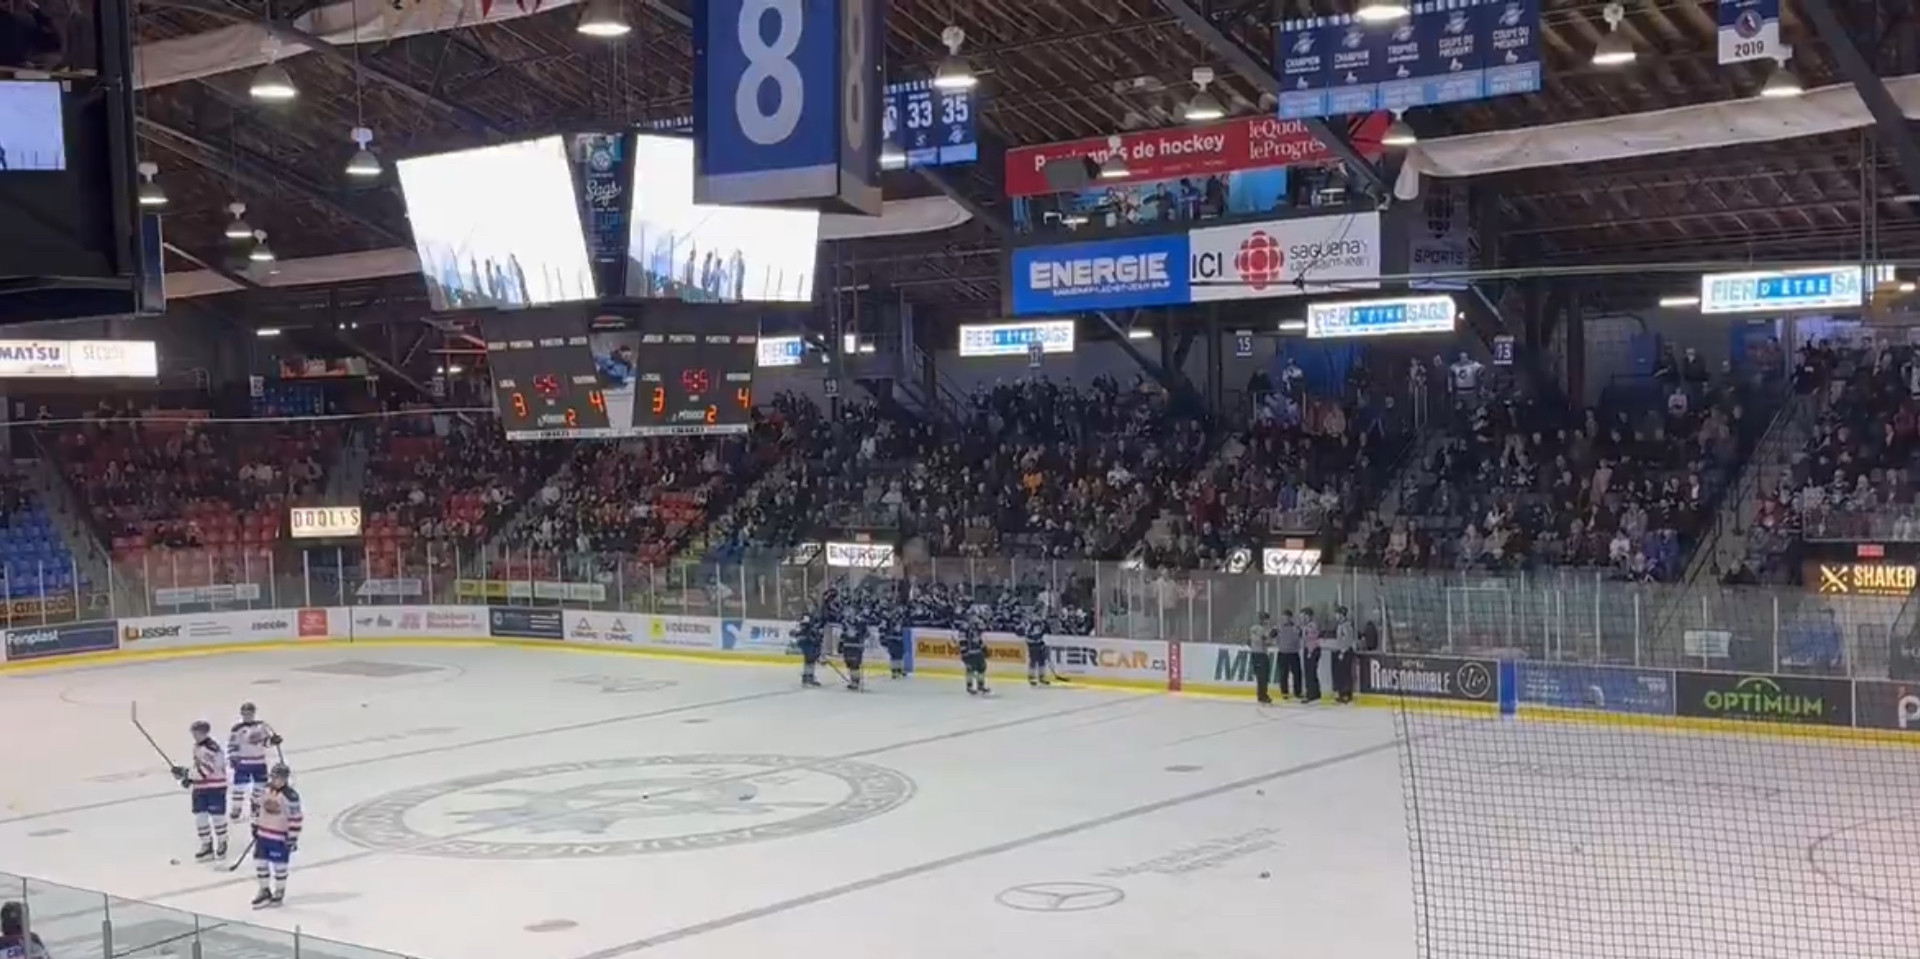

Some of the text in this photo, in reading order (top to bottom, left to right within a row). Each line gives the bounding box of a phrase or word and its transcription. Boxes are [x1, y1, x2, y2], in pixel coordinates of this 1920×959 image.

[736, 0, 804, 145] 8
[907, 100, 933, 128] 33
[941, 96, 969, 124] 35
[1133, 141, 1155, 159] de
[1160, 134, 1225, 156] hockey
[1191, 252, 1223, 279] ICI
[1238, 337, 1251, 352] 15
[588, 389, 604, 413] 4
[652, 387, 665, 413] 3
[737, 388, 751, 408] 4
[566, 408, 577, 427] 2
[706, 404, 718, 423] 2
[1853, 564, 1917, 588] SHAKER
